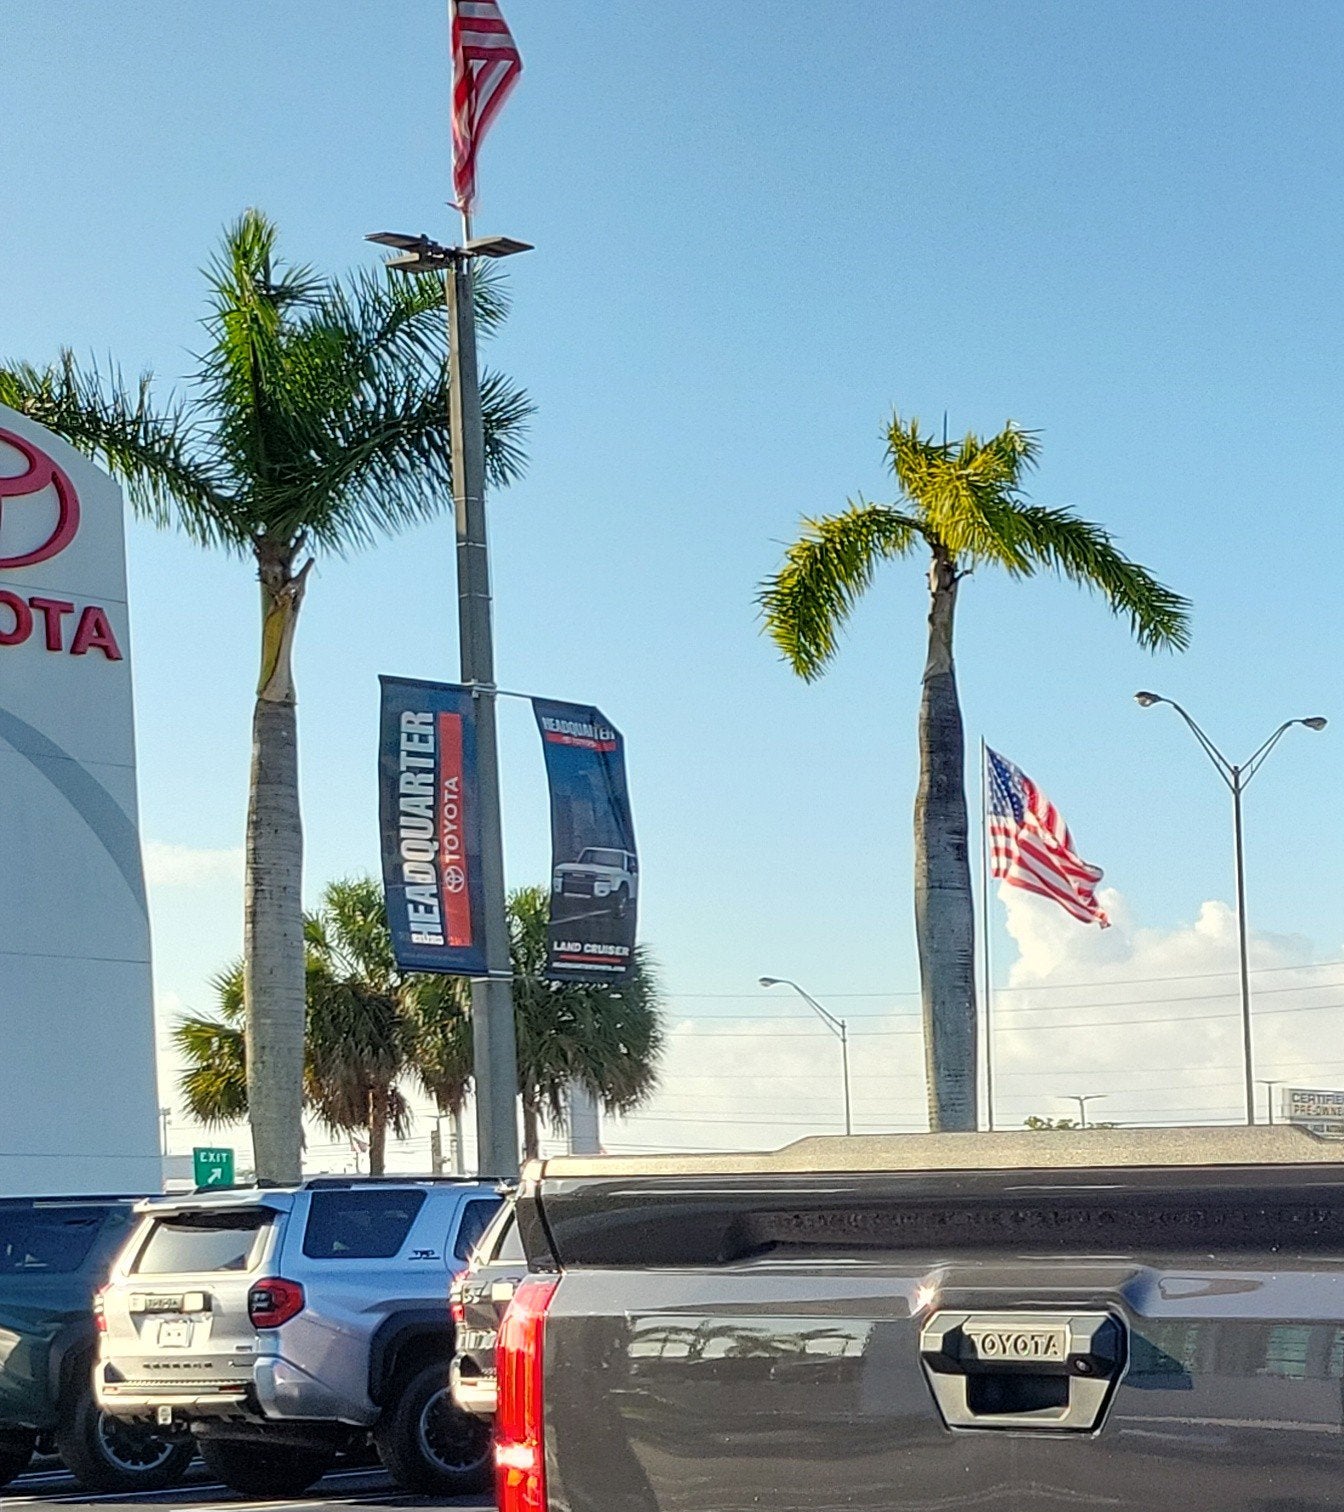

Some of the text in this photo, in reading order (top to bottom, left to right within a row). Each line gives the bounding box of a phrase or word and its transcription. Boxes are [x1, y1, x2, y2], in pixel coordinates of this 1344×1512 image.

[400, 710, 445, 946] HEADQUARTER
[444, 776, 460, 863] TOYOTA
[553, 941, 630, 956] LAND CRUISER
[200, 1152, 228, 1163] EXIT
